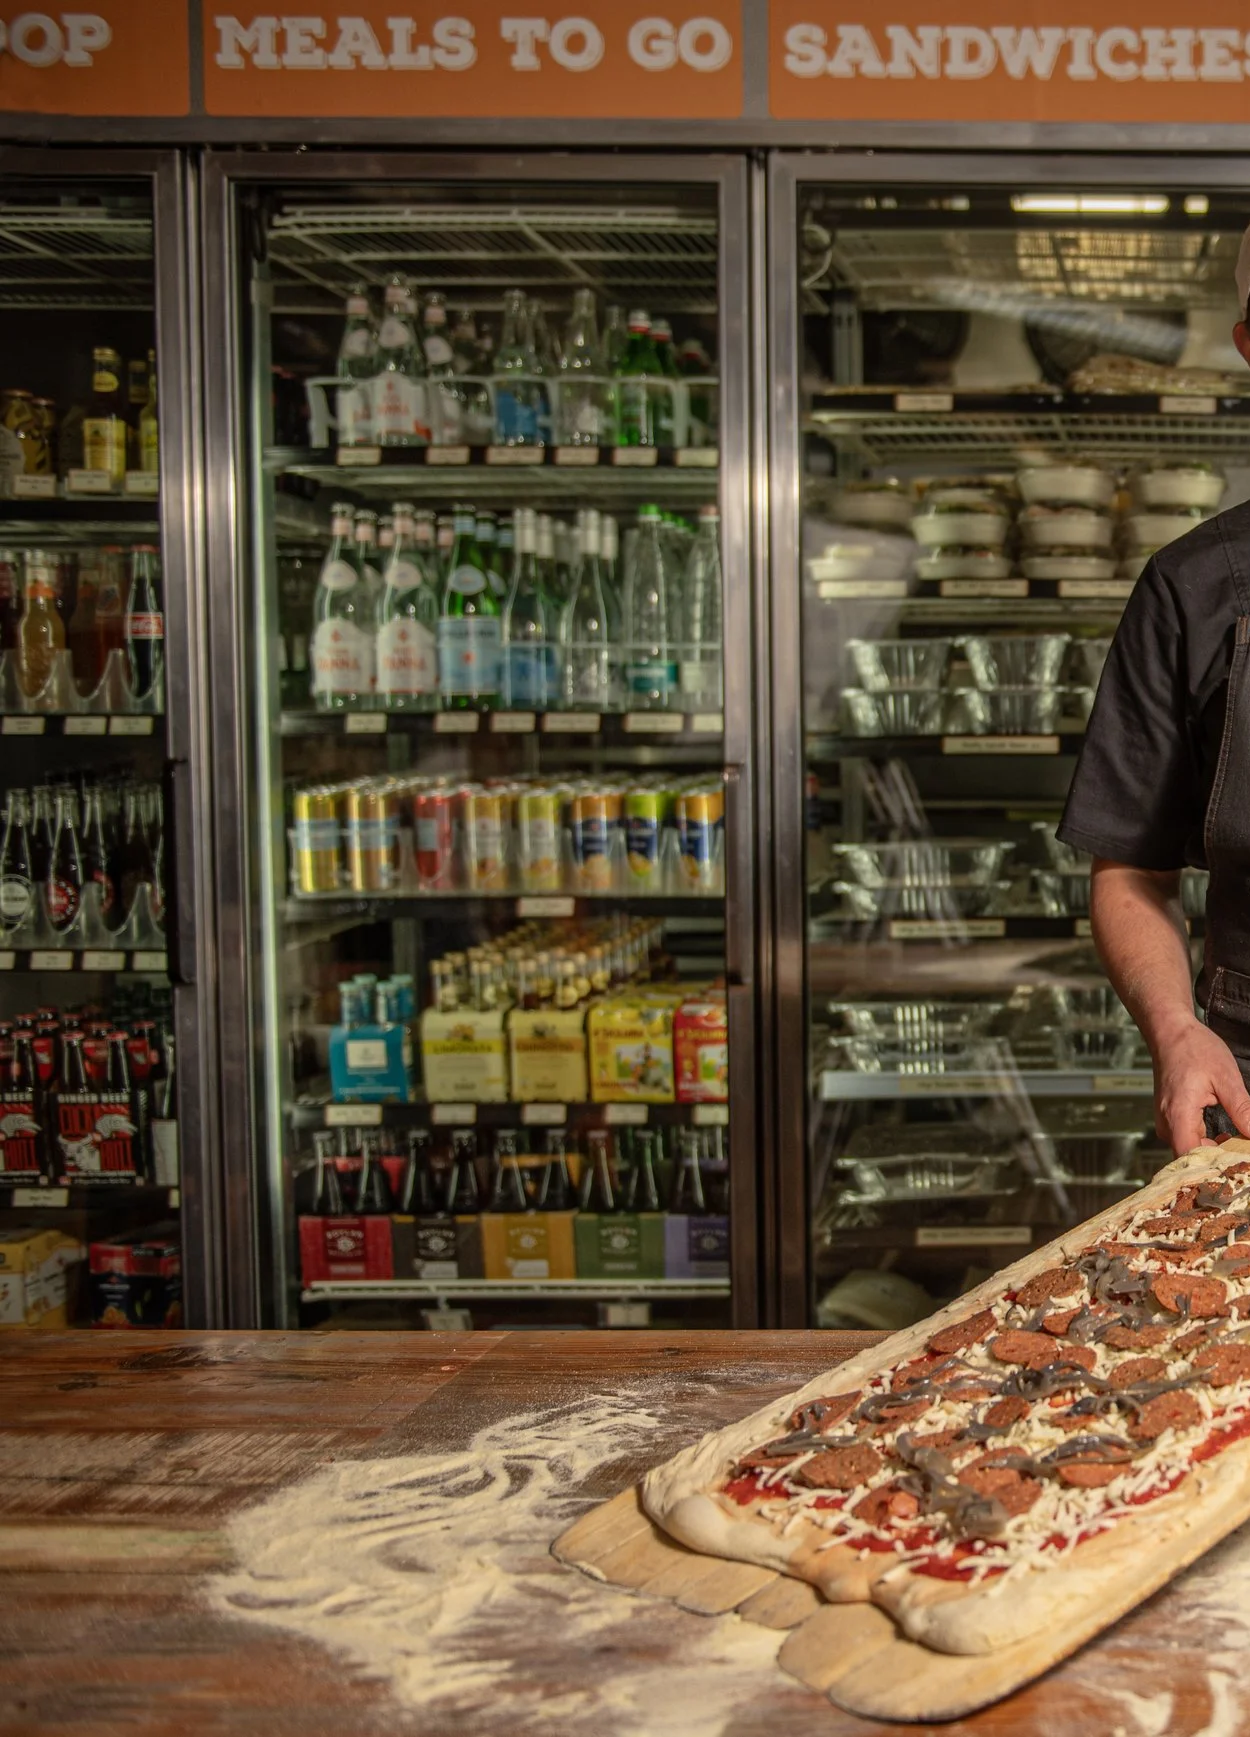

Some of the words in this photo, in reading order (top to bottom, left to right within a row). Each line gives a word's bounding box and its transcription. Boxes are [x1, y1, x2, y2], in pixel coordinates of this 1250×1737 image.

[0, 13, 112, 67] OP
[214, 15, 478, 71] MEALS
[500, 16, 605, 72] TO
[627, 16, 733, 72] GO
[57, 1092, 98, 1104] GINGER
[101, 1092, 130, 1104] BEER
